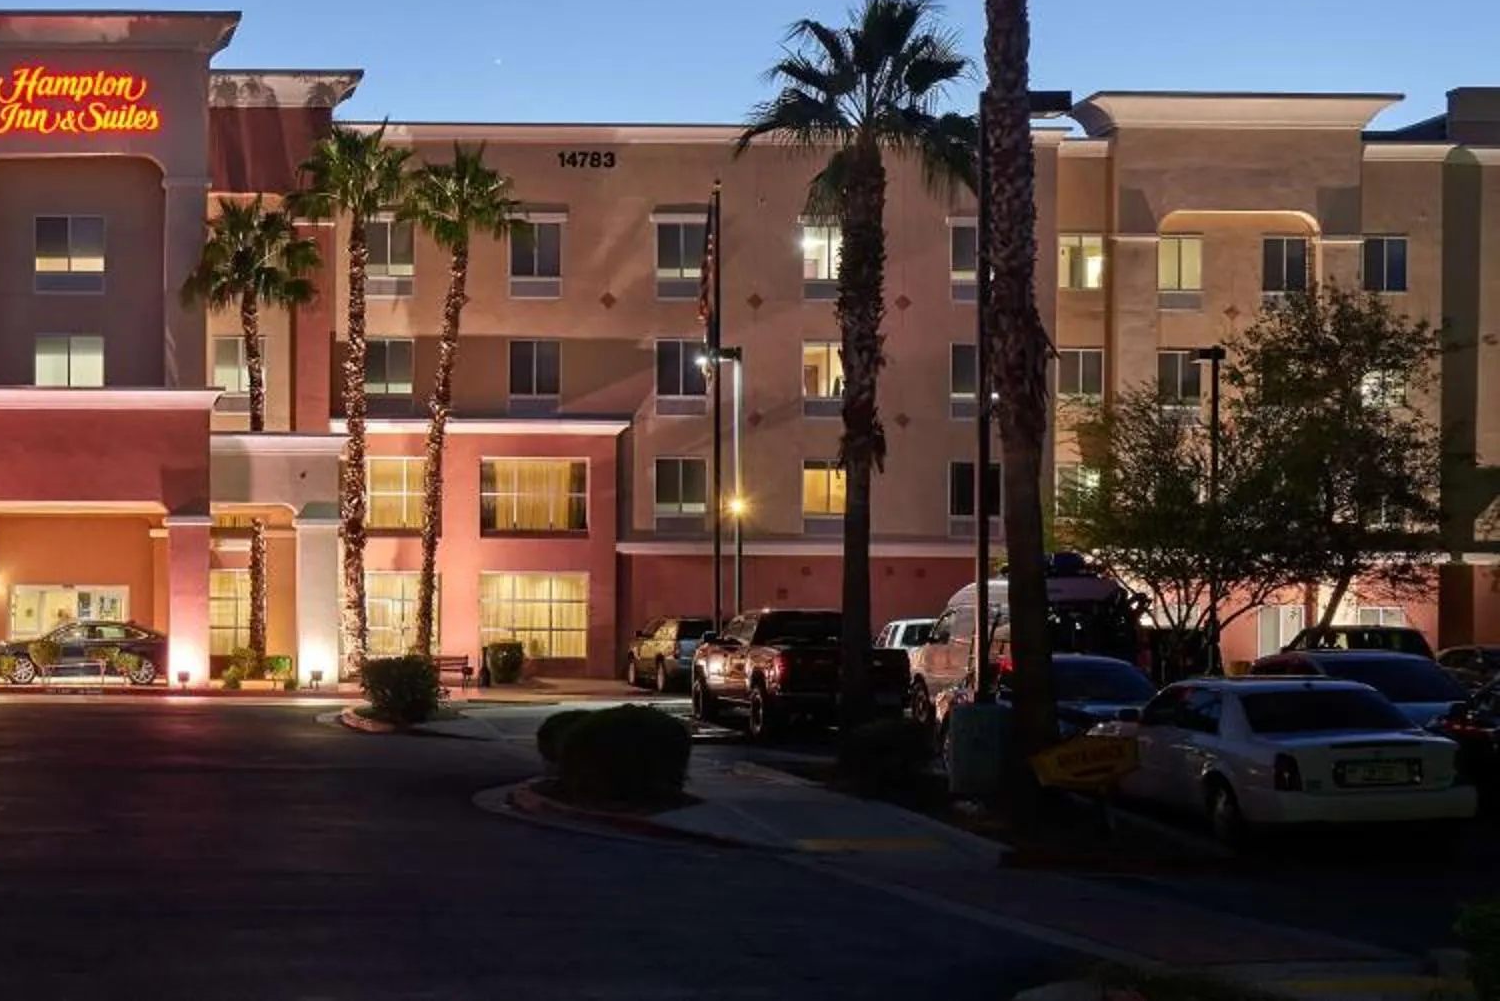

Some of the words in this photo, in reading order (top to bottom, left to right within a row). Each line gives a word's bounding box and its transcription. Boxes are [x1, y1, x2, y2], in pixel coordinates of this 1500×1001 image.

[60, 110, 79, 133] &
[78, 102, 160, 133] Suites
[558, 151, 616, 168] 14783
